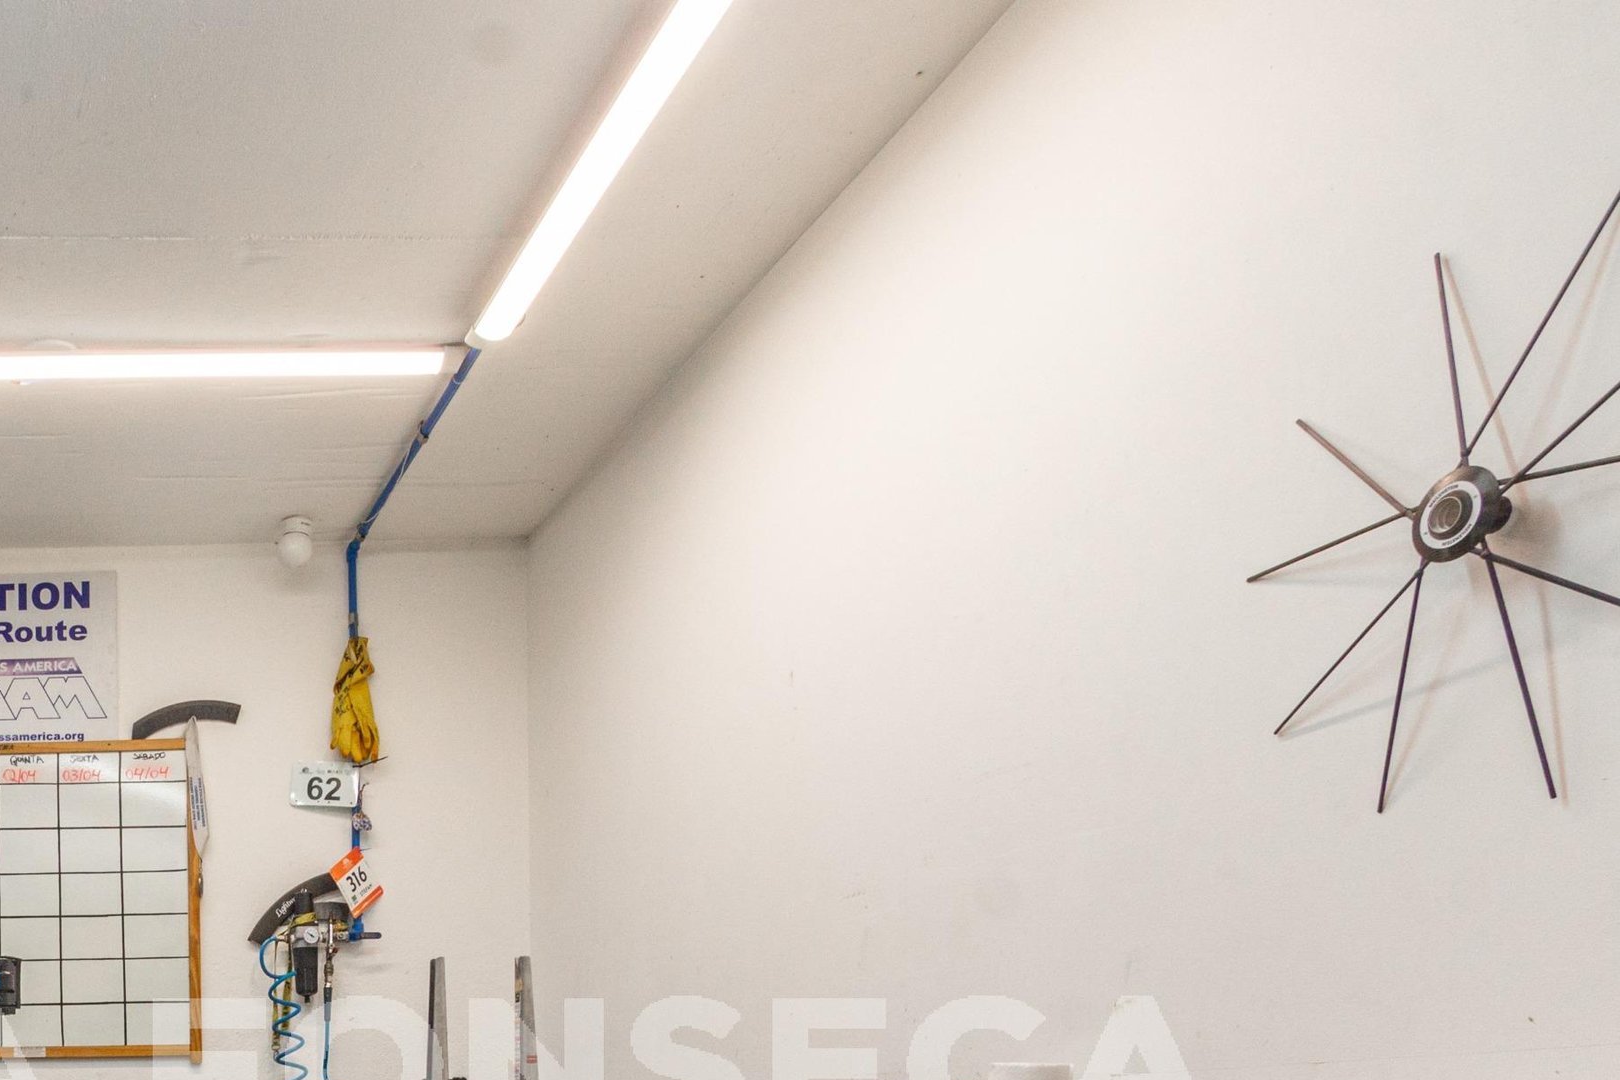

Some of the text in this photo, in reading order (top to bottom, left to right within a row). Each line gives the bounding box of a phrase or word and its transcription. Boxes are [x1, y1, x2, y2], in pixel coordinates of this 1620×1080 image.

[13, 659, 78, 673] AMERICA
[2, 769, 37, 784] 02/04
[62, 768, 101, 782] 03/04
[125, 766, 169, 780] 04/04
[307, 776, 342, 801] 62
[346, 867, 368, 893] 316
